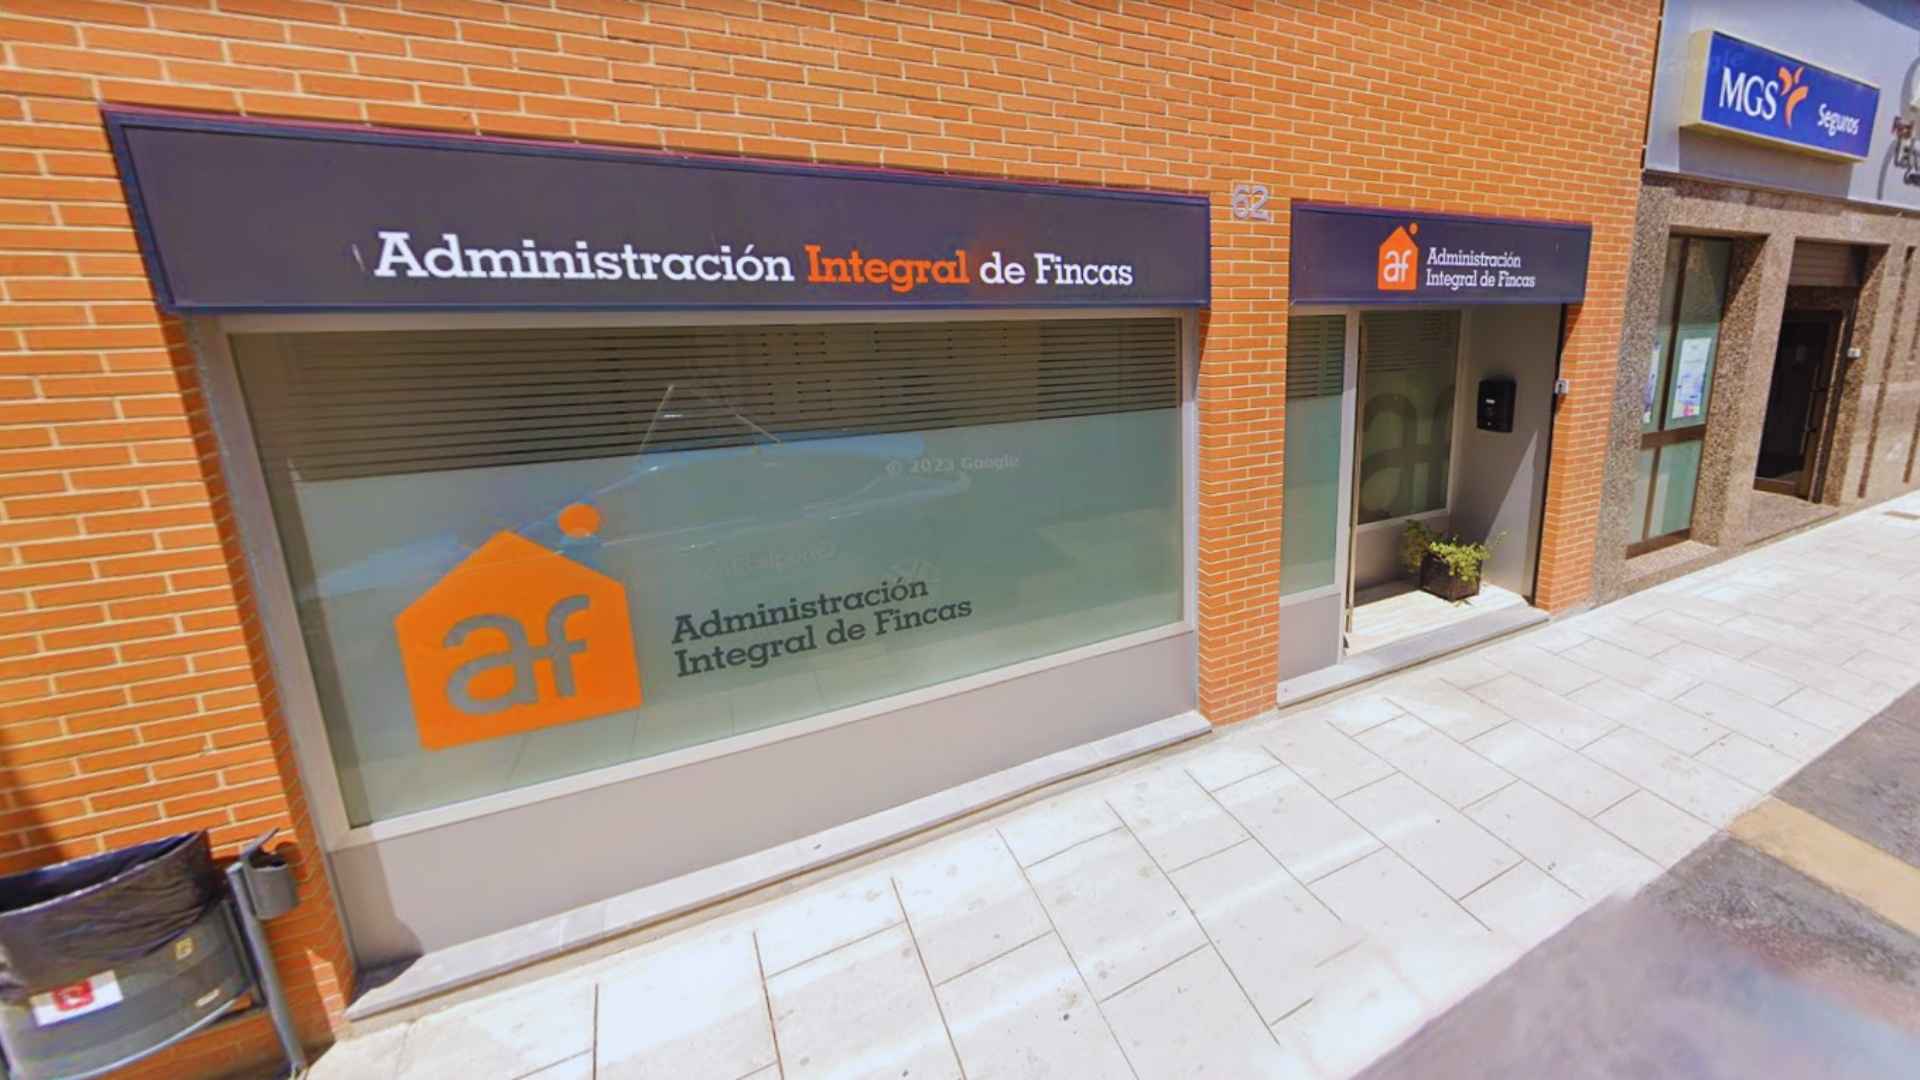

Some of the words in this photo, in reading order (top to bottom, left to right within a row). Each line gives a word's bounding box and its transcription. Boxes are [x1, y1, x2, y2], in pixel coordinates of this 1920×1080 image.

[1719, 66, 1779, 121] MGS
[1817, 103, 1861, 137] Seguros
[1232, 183, 1271, 220] 62
[374, 231, 795, 282] Administración
[805, 244, 971, 293] Integral
[979, 251, 1026, 286] de
[1034, 252, 1134, 287] Fincas
[1426, 268, 1477, 291] Integral
[1480, 271, 1495, 287] de
[1498, 271, 1536, 289] Fincas
[1427, 247, 1521, 269] Administración
[671, 576, 929, 644] Administración
[443, 595, 590, 715] af
[674, 625, 817, 678] Integral
[826, 619, 866, 646] de
[874, 600, 973, 637] Fincas
